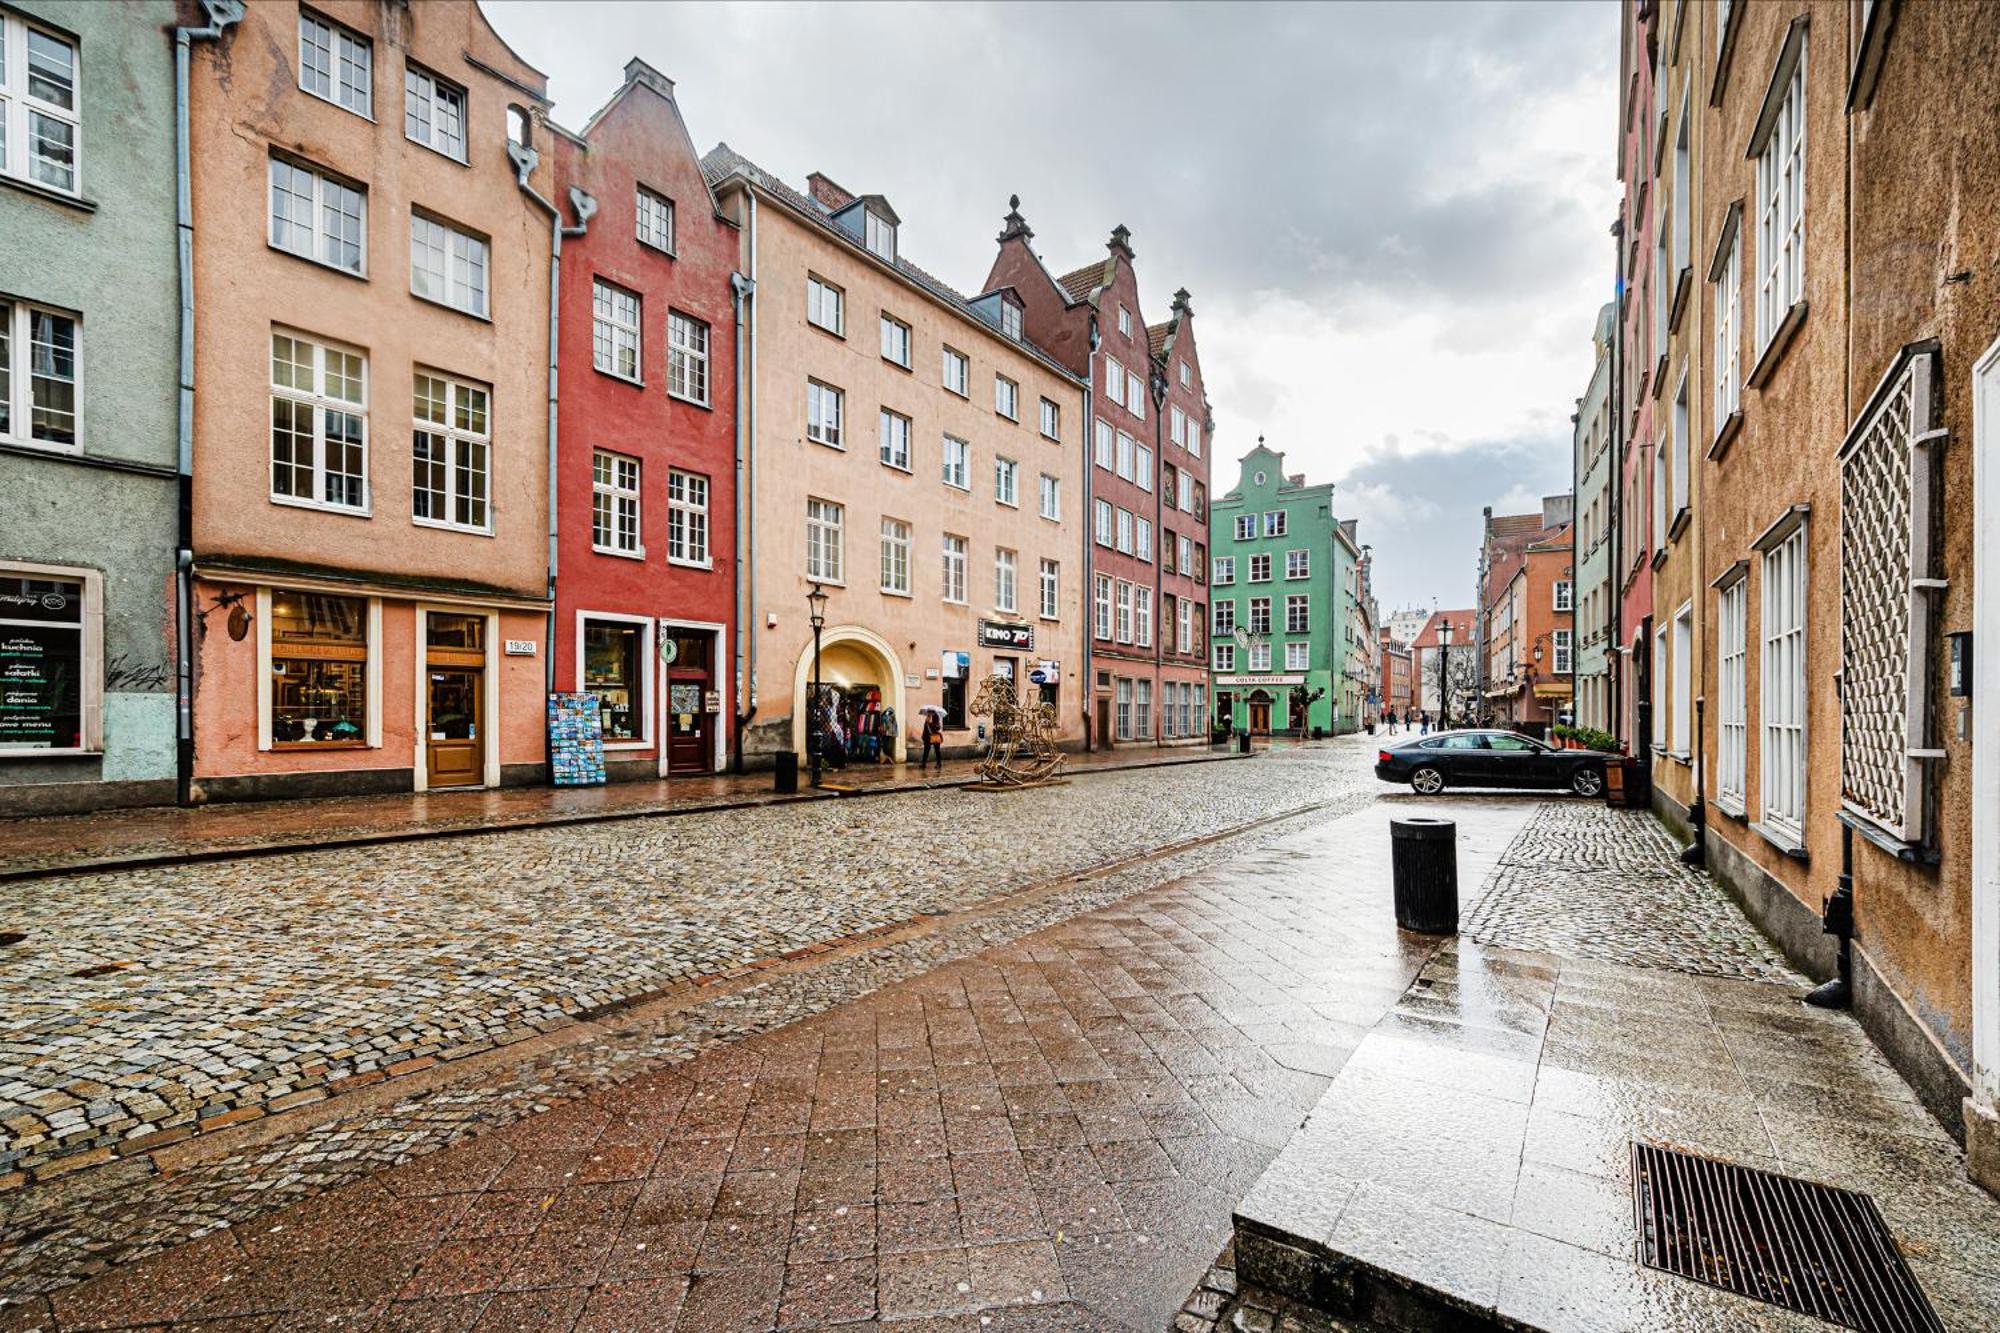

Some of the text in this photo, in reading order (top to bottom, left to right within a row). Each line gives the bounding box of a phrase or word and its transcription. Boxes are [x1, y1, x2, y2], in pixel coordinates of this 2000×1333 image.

[986, 627, 1011, 641] KINO
[1, 642, 43, 652] kuchnia
[6, 696, 38, 704] dania
